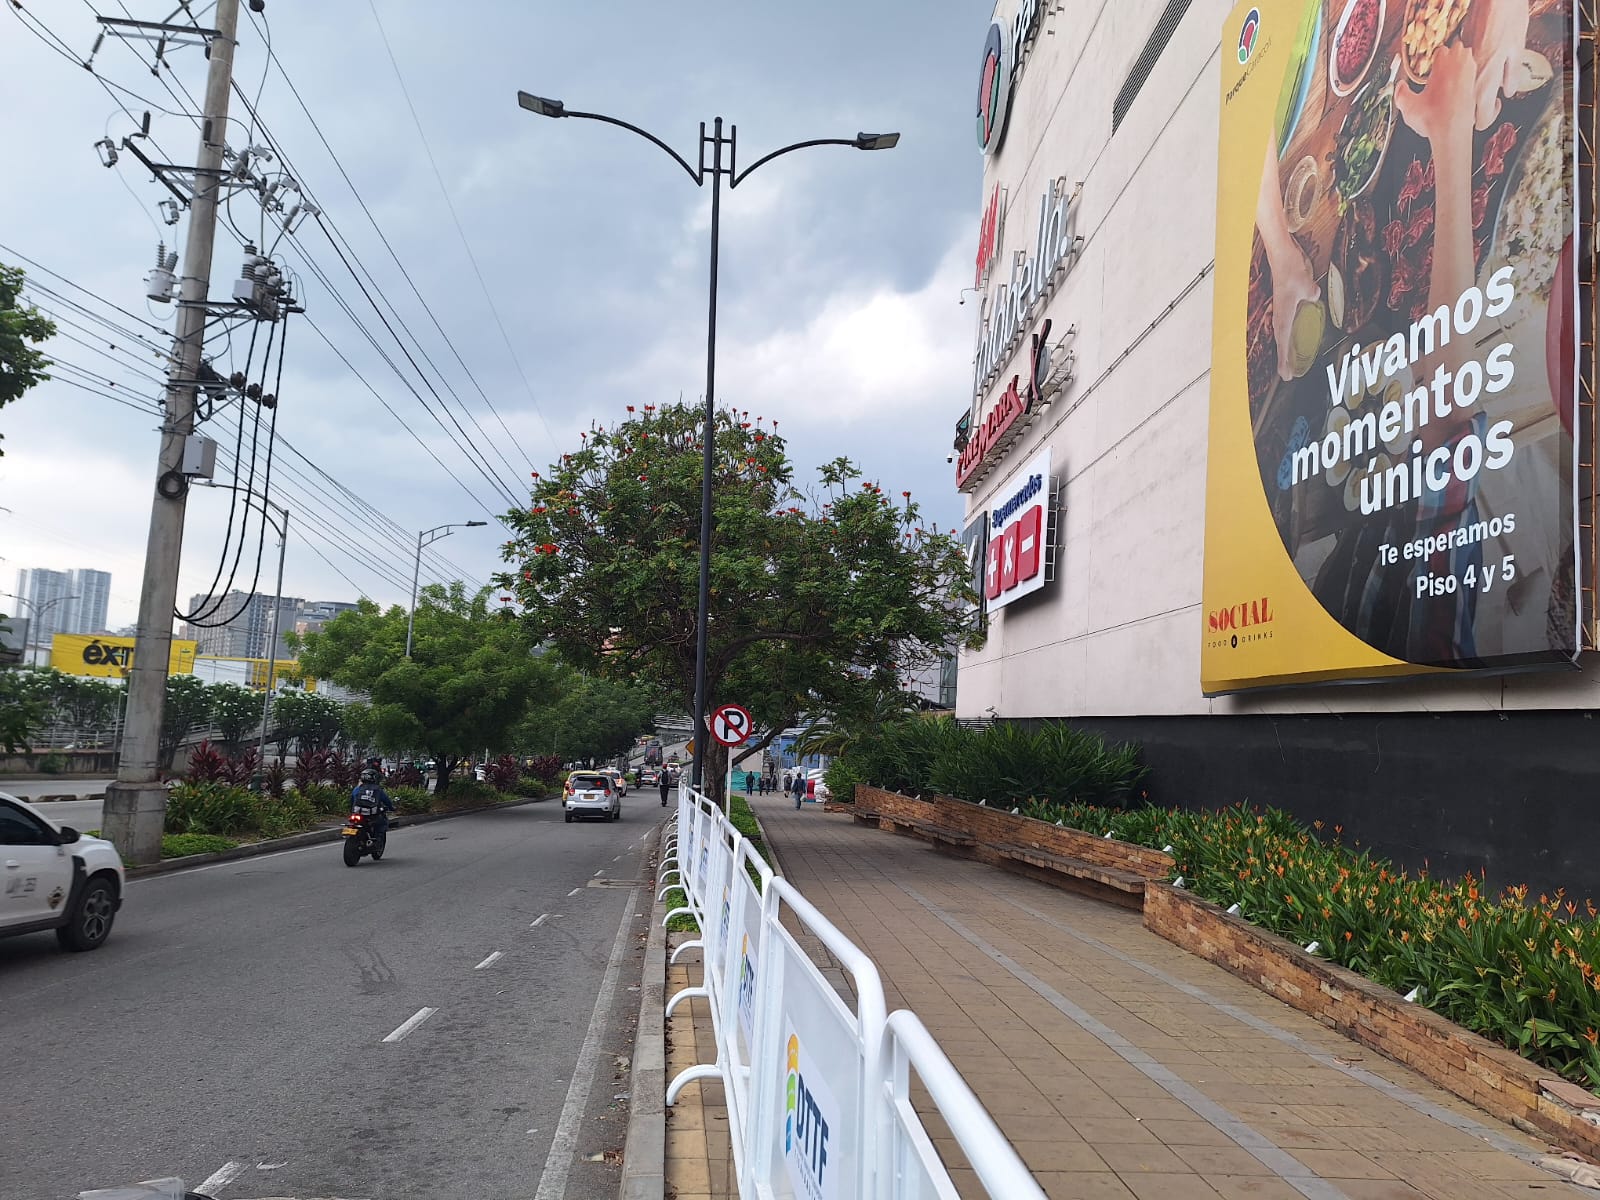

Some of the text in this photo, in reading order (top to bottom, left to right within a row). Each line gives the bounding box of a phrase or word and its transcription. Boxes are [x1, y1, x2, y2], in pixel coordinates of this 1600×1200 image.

[1326, 265, 1515, 407] Vivamos
[956, 375, 1024, 489] CINEMARK
[1292, 343, 1515, 486] momentos
[1360, 420, 1515, 516] únicos
[1378, 513, 1516, 566] Te esperamos
[1416, 554, 1516, 599] Piso 4 y 5
[1208, 597, 1274, 633] SOCIAL
[1241, 631, 1273, 643] DRINKS
[723, 710, 744, 740] P
[796, 1071, 829, 1187] DTTF
